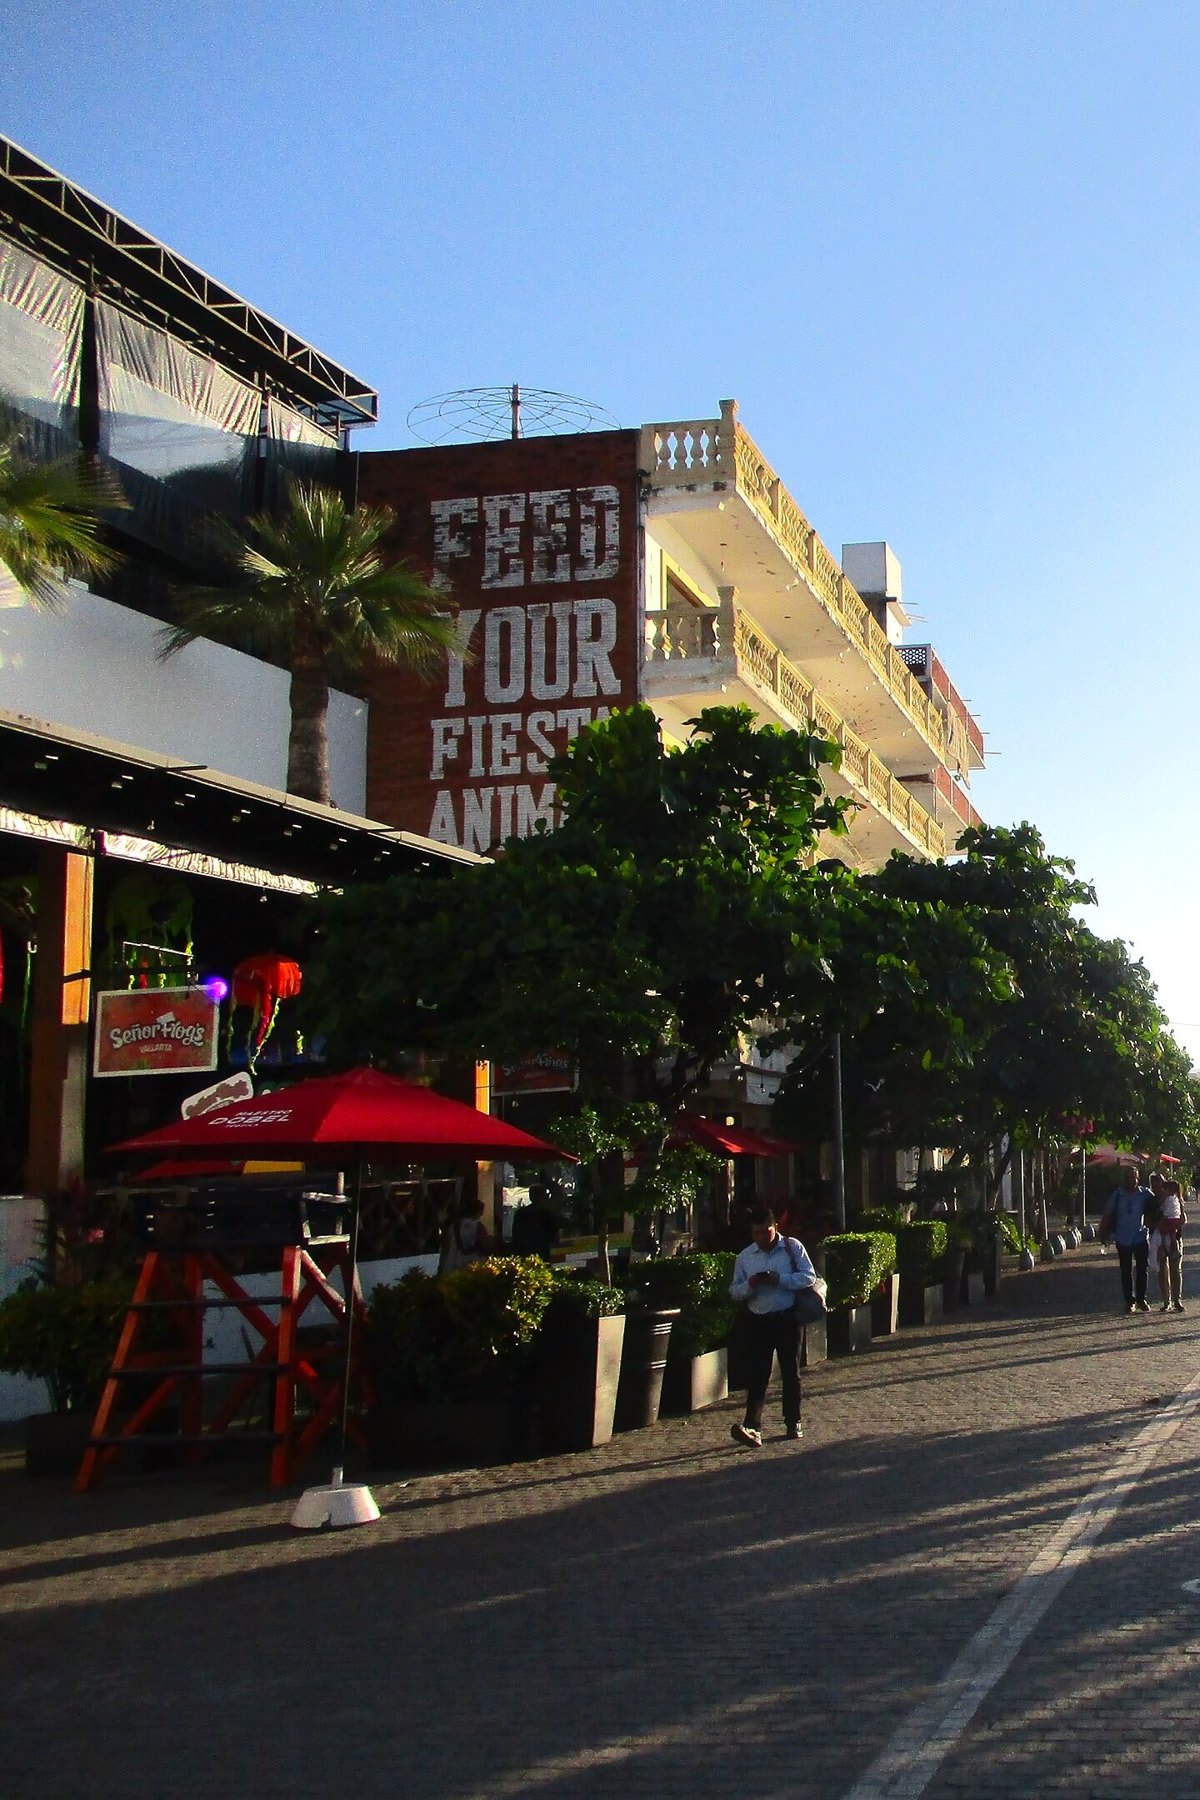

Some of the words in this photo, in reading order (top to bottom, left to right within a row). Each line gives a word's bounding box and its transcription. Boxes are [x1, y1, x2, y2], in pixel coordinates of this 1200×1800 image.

[430, 485, 620, 592] FEED
[437, 598, 621, 708] YOUR
[428, 783, 569, 852] ANIM
[110, 1022, 160, 1049] Señor
[208, 1115, 289, 1125] DOBEL
